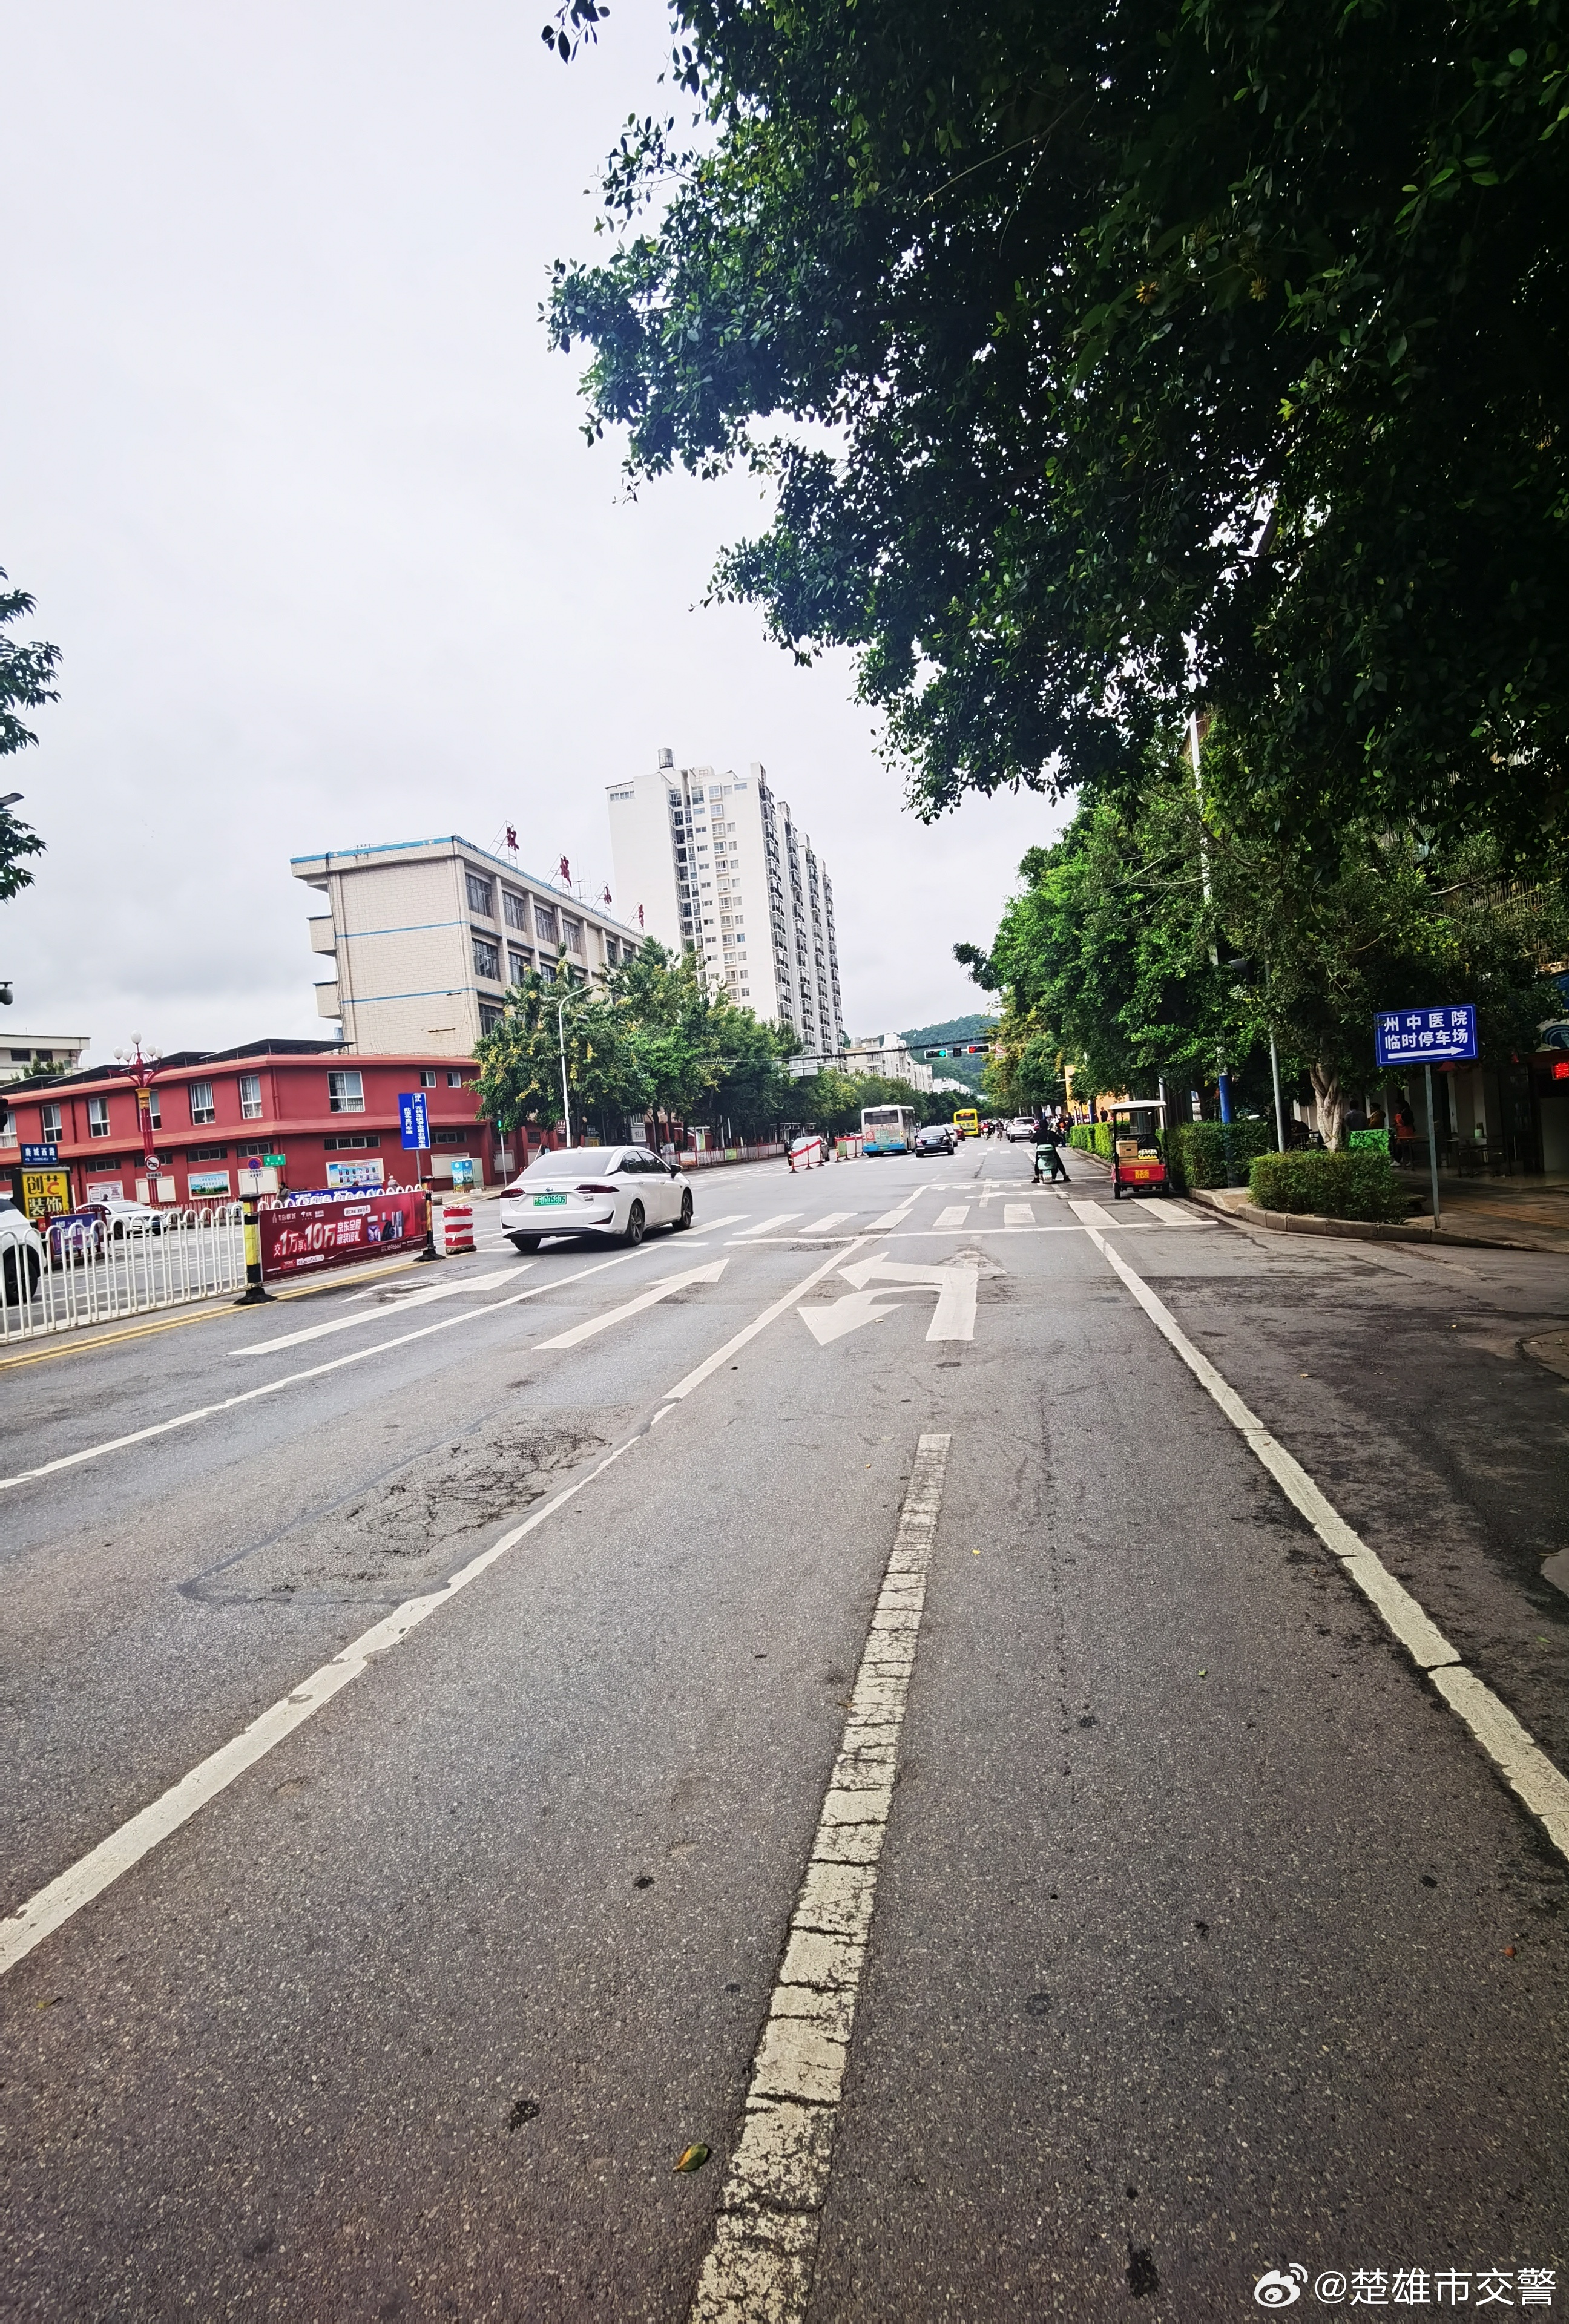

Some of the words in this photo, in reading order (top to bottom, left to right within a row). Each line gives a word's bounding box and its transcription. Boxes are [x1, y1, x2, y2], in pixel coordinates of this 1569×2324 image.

[1383, 1010, 1468, 1032] 州中医院
[1384, 1029, 1469, 1050] 临时停车场
[27, 1175, 60, 1195] 创艺
[28, 1196, 62, 1216] 装饰
